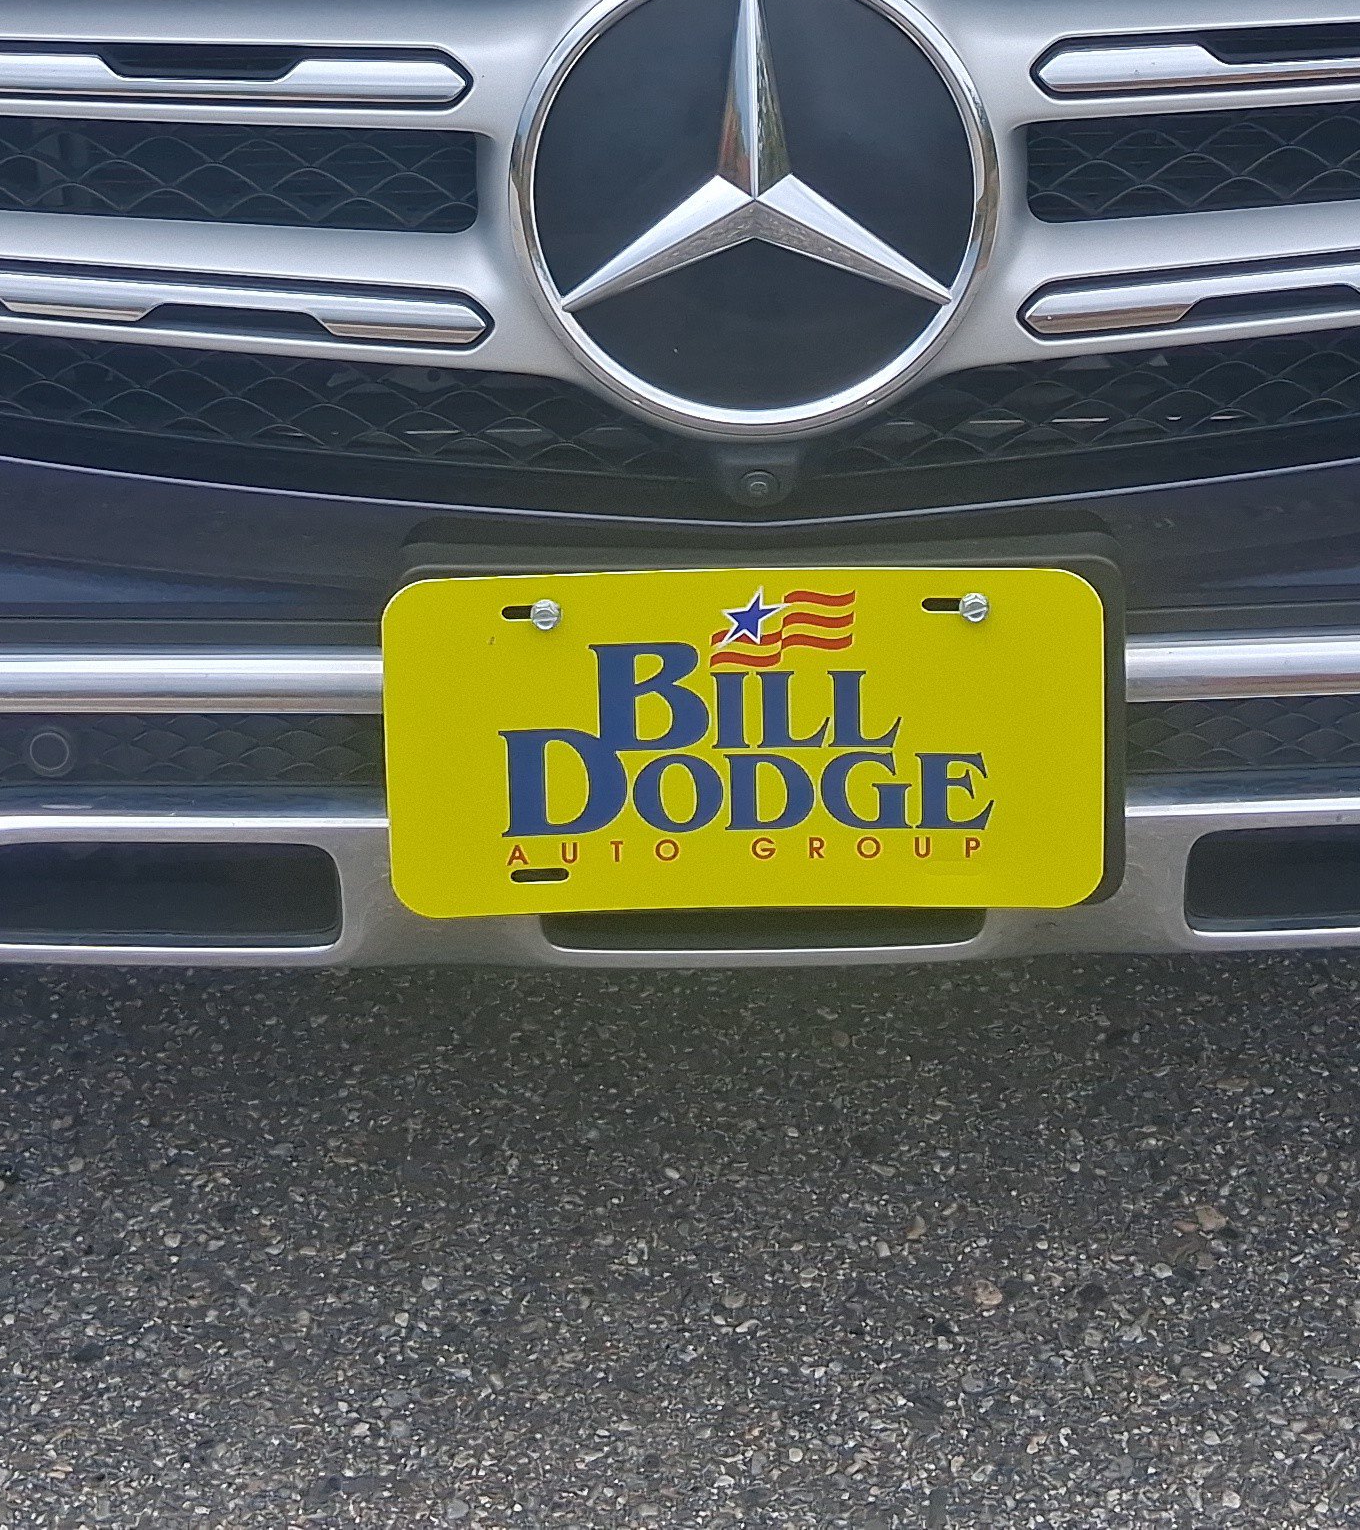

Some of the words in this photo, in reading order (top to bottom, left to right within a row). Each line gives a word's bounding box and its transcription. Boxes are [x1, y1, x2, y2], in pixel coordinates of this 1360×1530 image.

[589, 642, 902, 751] BILL
[498, 728, 995, 837] DODGE
[507, 839, 680, 865] AUTO
[751, 836, 983, 861] GROUP
